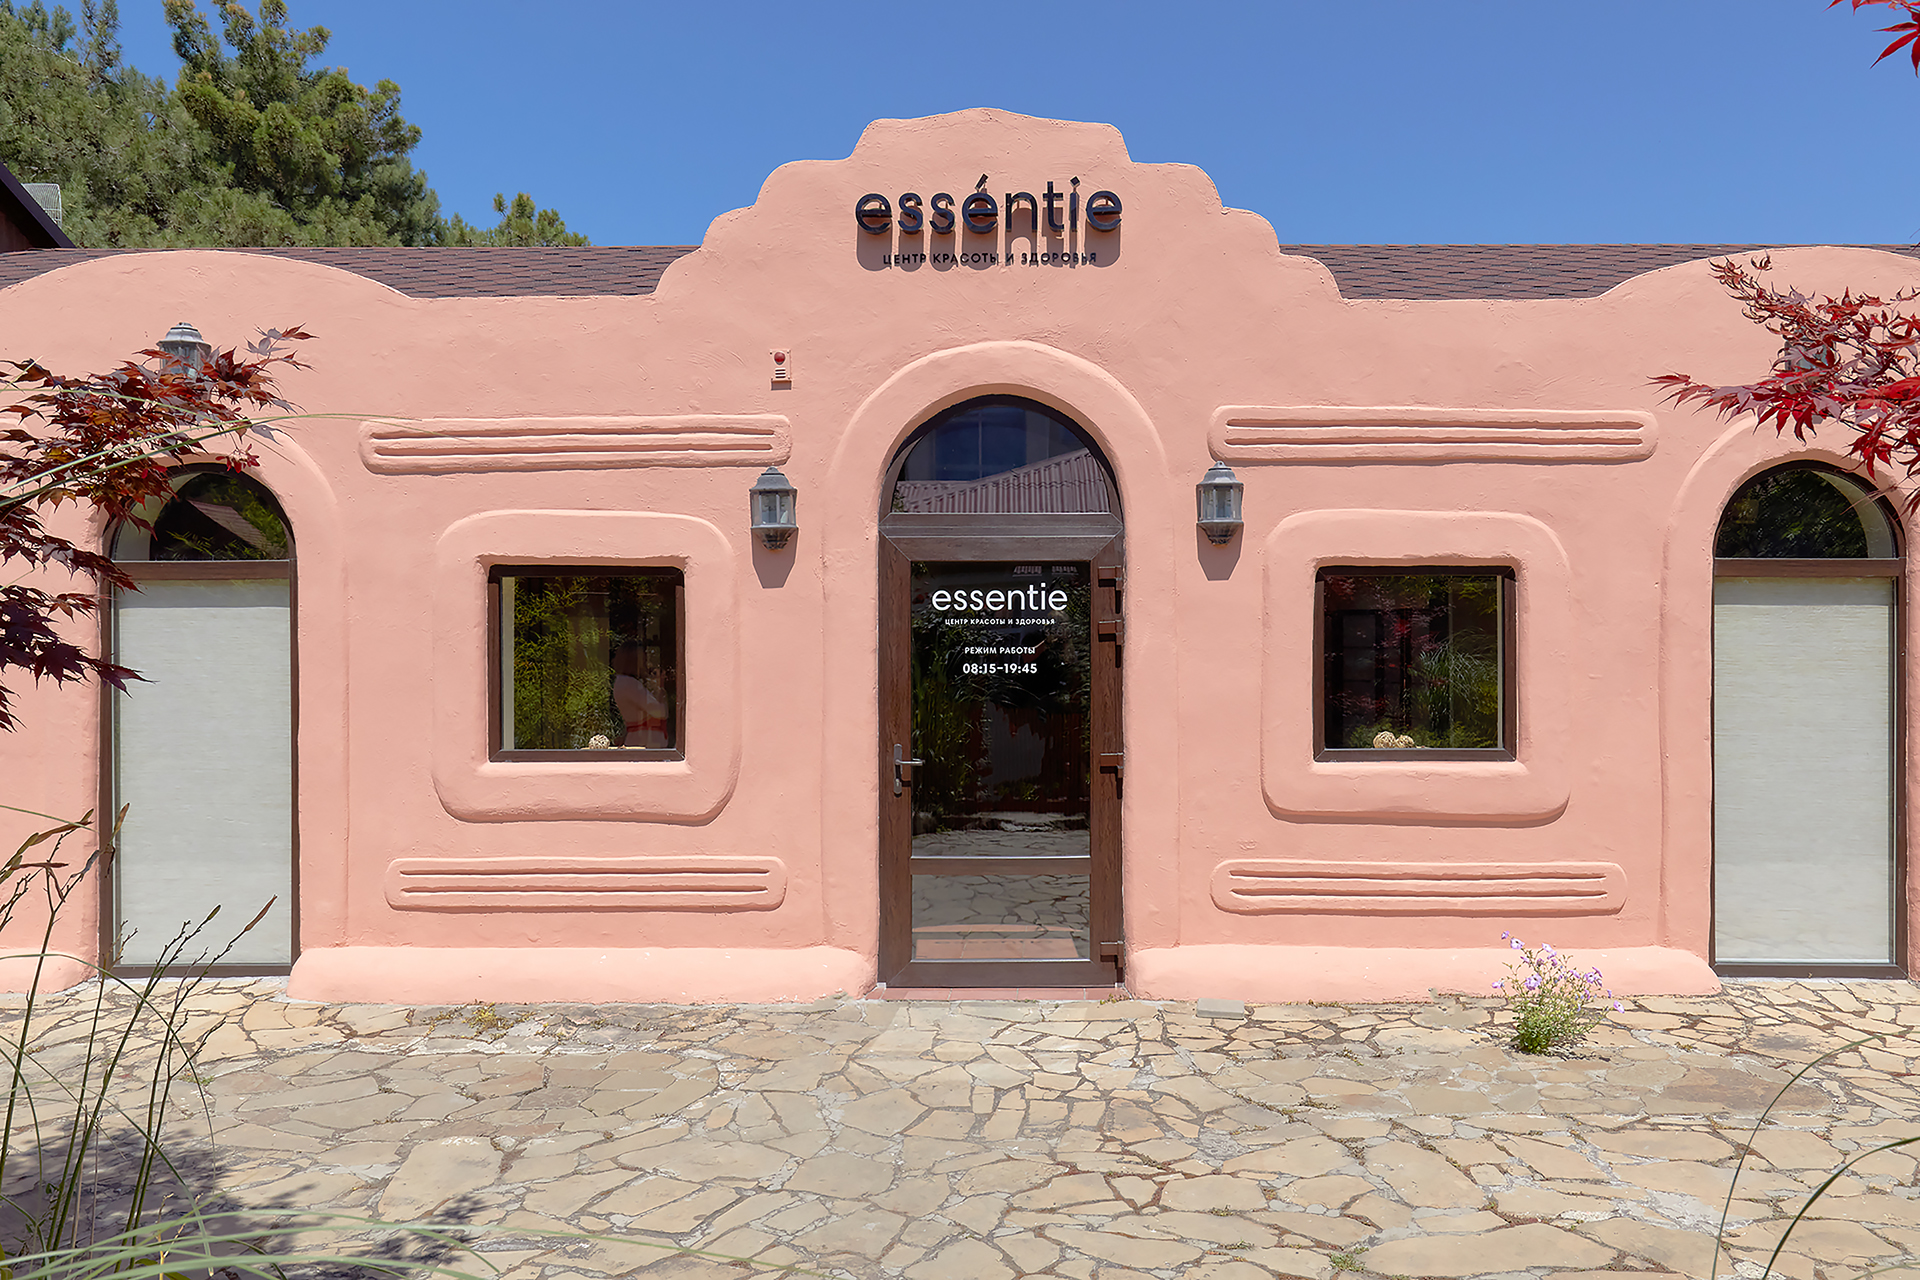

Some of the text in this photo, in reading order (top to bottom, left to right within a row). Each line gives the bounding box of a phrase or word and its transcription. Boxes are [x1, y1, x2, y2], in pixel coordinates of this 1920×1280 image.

[883, 252, 1097, 266] ЦЕНТР КРАСОТЫ И ЗДОРОВЬЯ
[932, 583, 1068, 611] essentie
[945, 618, 968, 626] ЦЕНТР
[1015, 618, 1055, 626] ЗДОРОВЬЯ
[964, 646, 1036, 655] РЕЖИМ РАБОТЫ
